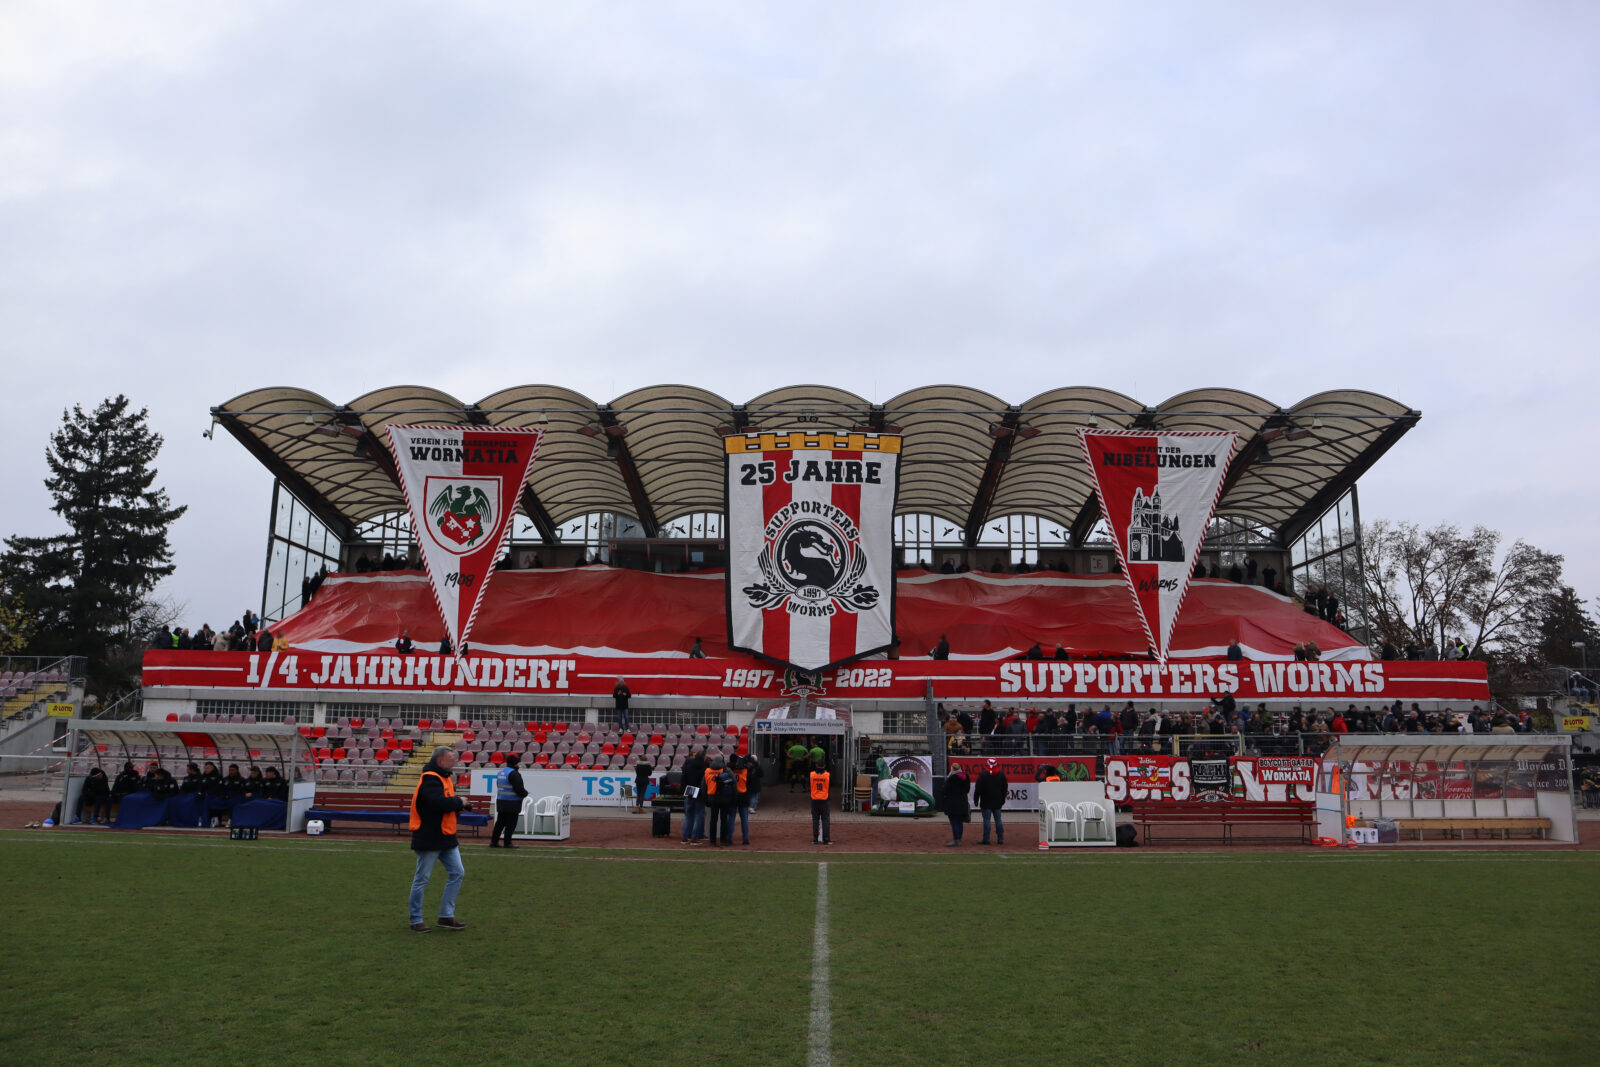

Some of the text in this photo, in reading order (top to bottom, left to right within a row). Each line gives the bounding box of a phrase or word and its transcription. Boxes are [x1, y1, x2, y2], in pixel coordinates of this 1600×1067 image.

[411, 437, 440, 446] VEREIN
[443, 437, 460, 446] FÜR
[410, 446, 518, 463] WORMATIA
[1136, 446, 1181, 454] STADT DER
[1103, 453, 1216, 468] NIBELUNGEN
[740, 459, 882, 485] 25 JAHRE
[764, 500, 861, 541] SUPPORTERS
[444, 572, 475, 588] 1908
[803, 588, 821, 598] 1997
[786, 600, 836, 617] WORMS
[722, 667, 893, 689] 1997 2022
[1259, 758, 1314, 768] BOYCOTT QATAR
[1262, 769, 1311, 782] WORMATIA
